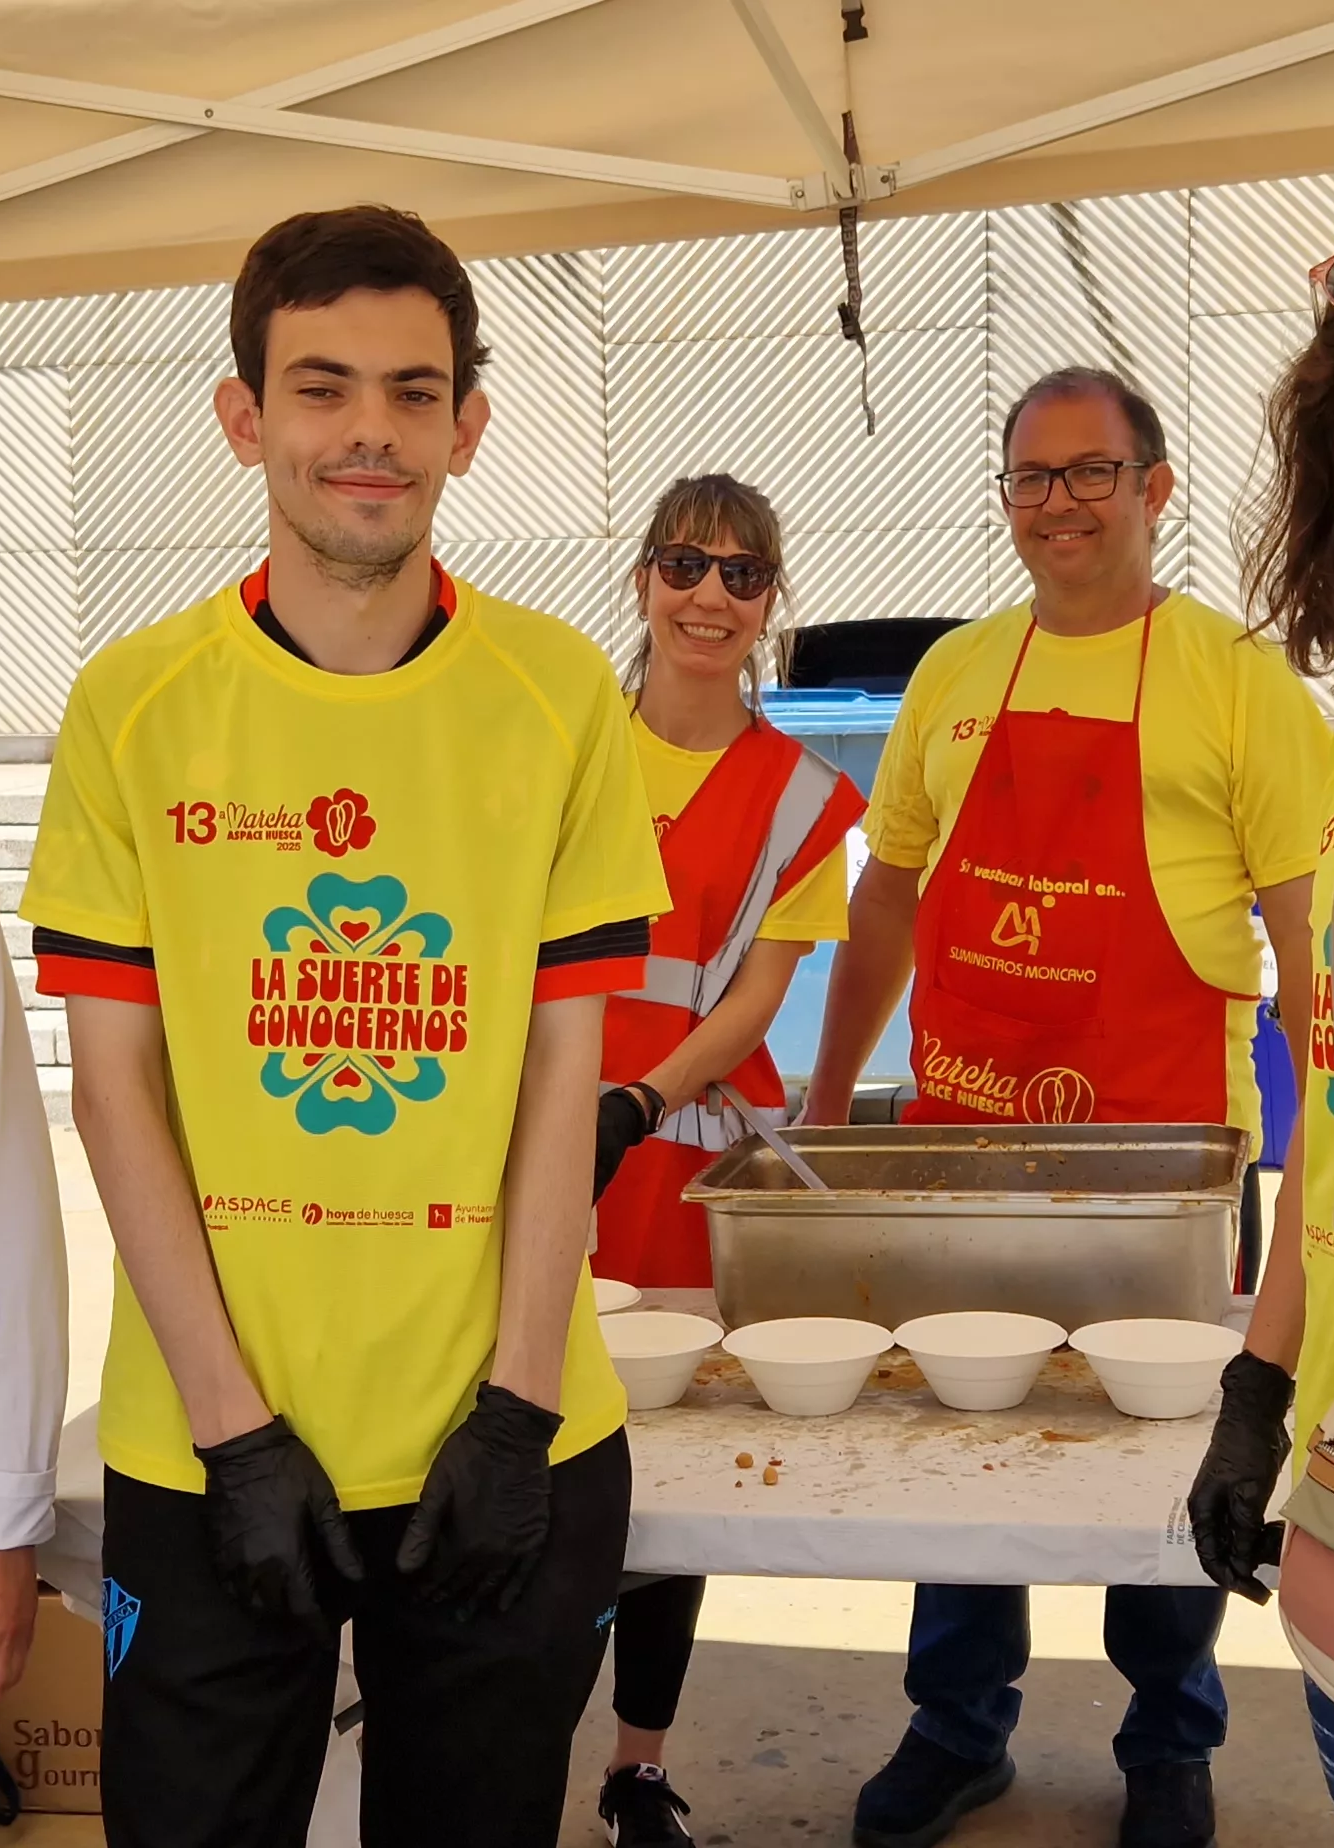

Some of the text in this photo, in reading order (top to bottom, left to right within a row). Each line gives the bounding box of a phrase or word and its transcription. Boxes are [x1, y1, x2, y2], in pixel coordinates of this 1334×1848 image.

[226, 802, 304, 829] Marcha
[227, 830, 302, 841] ASPACE HUESCA
[276, 842, 301, 852] 2025
[1028, 874, 1089, 895] laboral
[949, 945, 1097, 984] SUMINISTROS MONCAYO
[252, 958, 468, 1007] LA SUERTE DE
[248, 1003, 468, 1053] CONOCERNOS
[956, 1089, 1015, 1118] HUESCA
[214, 1196, 292, 1214] ASPACE
[326, 1208, 414, 1221] hoya de huesca
